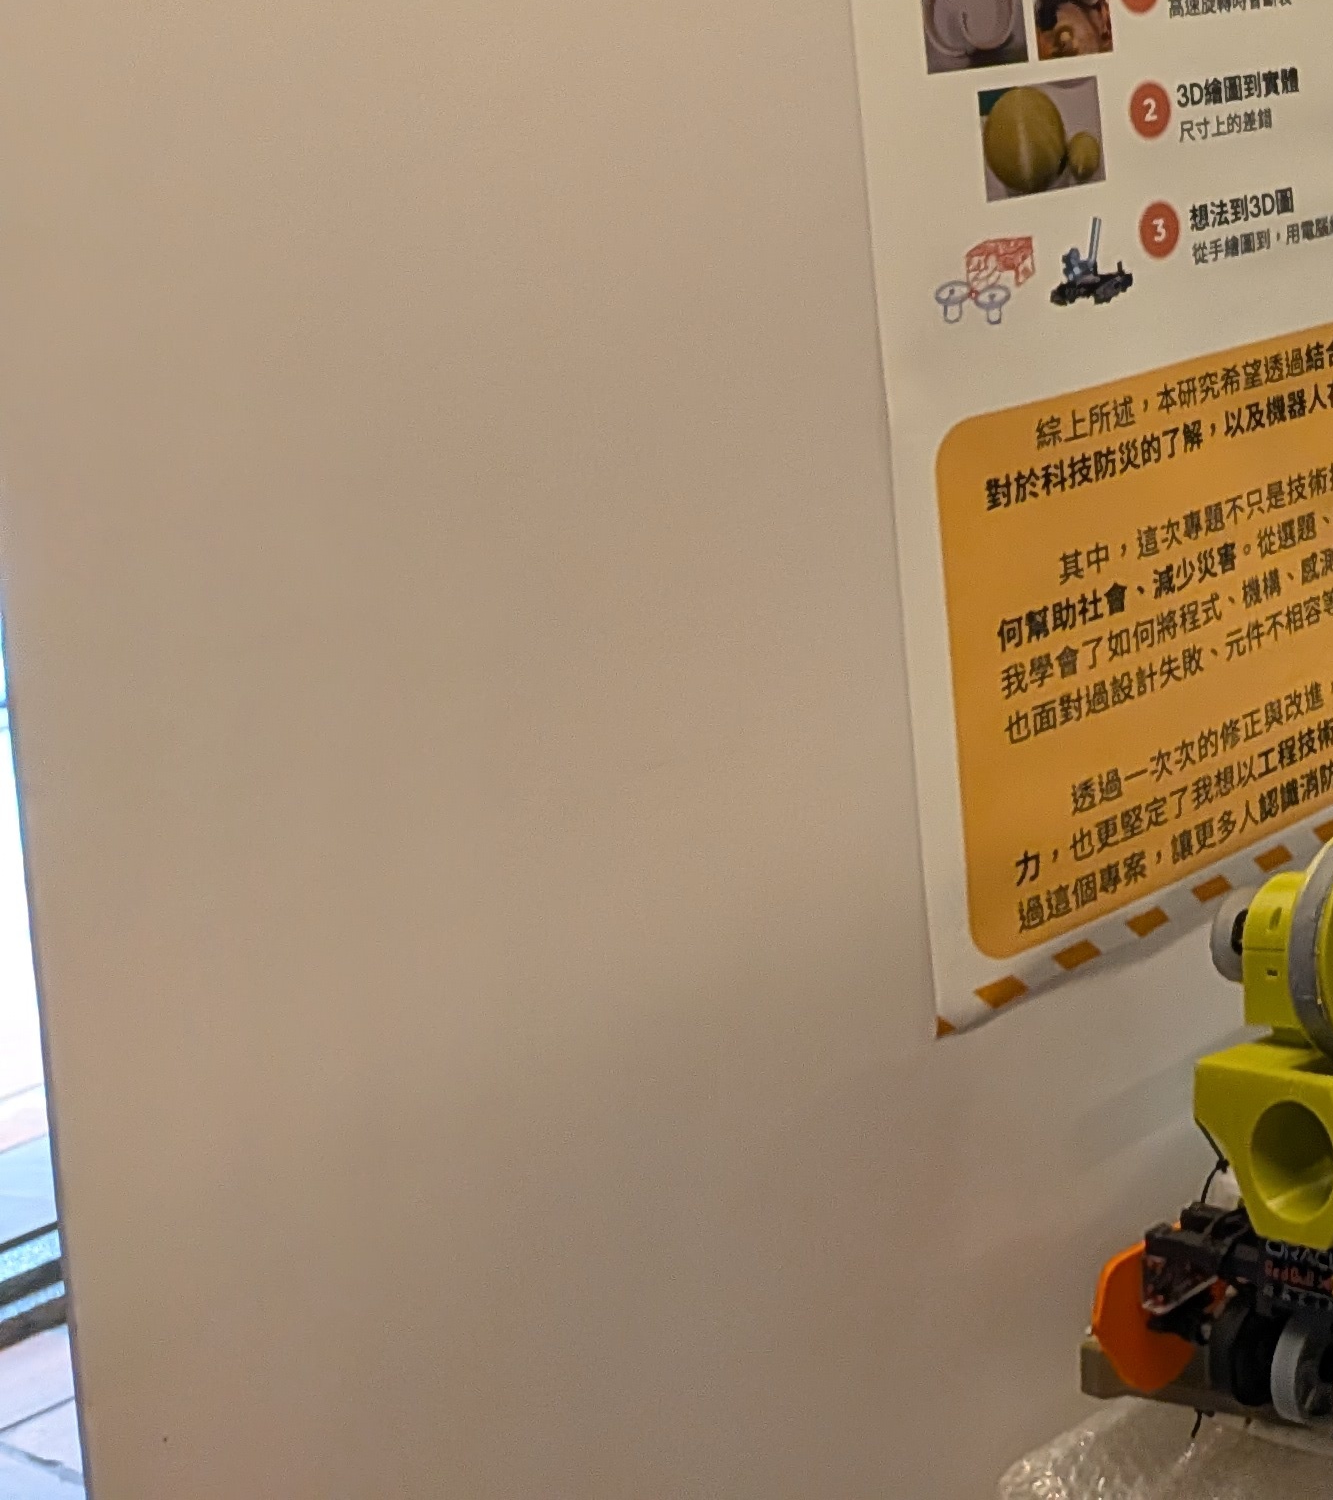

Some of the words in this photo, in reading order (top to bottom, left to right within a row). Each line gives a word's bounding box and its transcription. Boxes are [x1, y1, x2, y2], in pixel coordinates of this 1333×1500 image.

[1176, 66, 1300, 111] 3D繪圖到實體
[1188, 187, 1295, 232] 想法到3D圖
